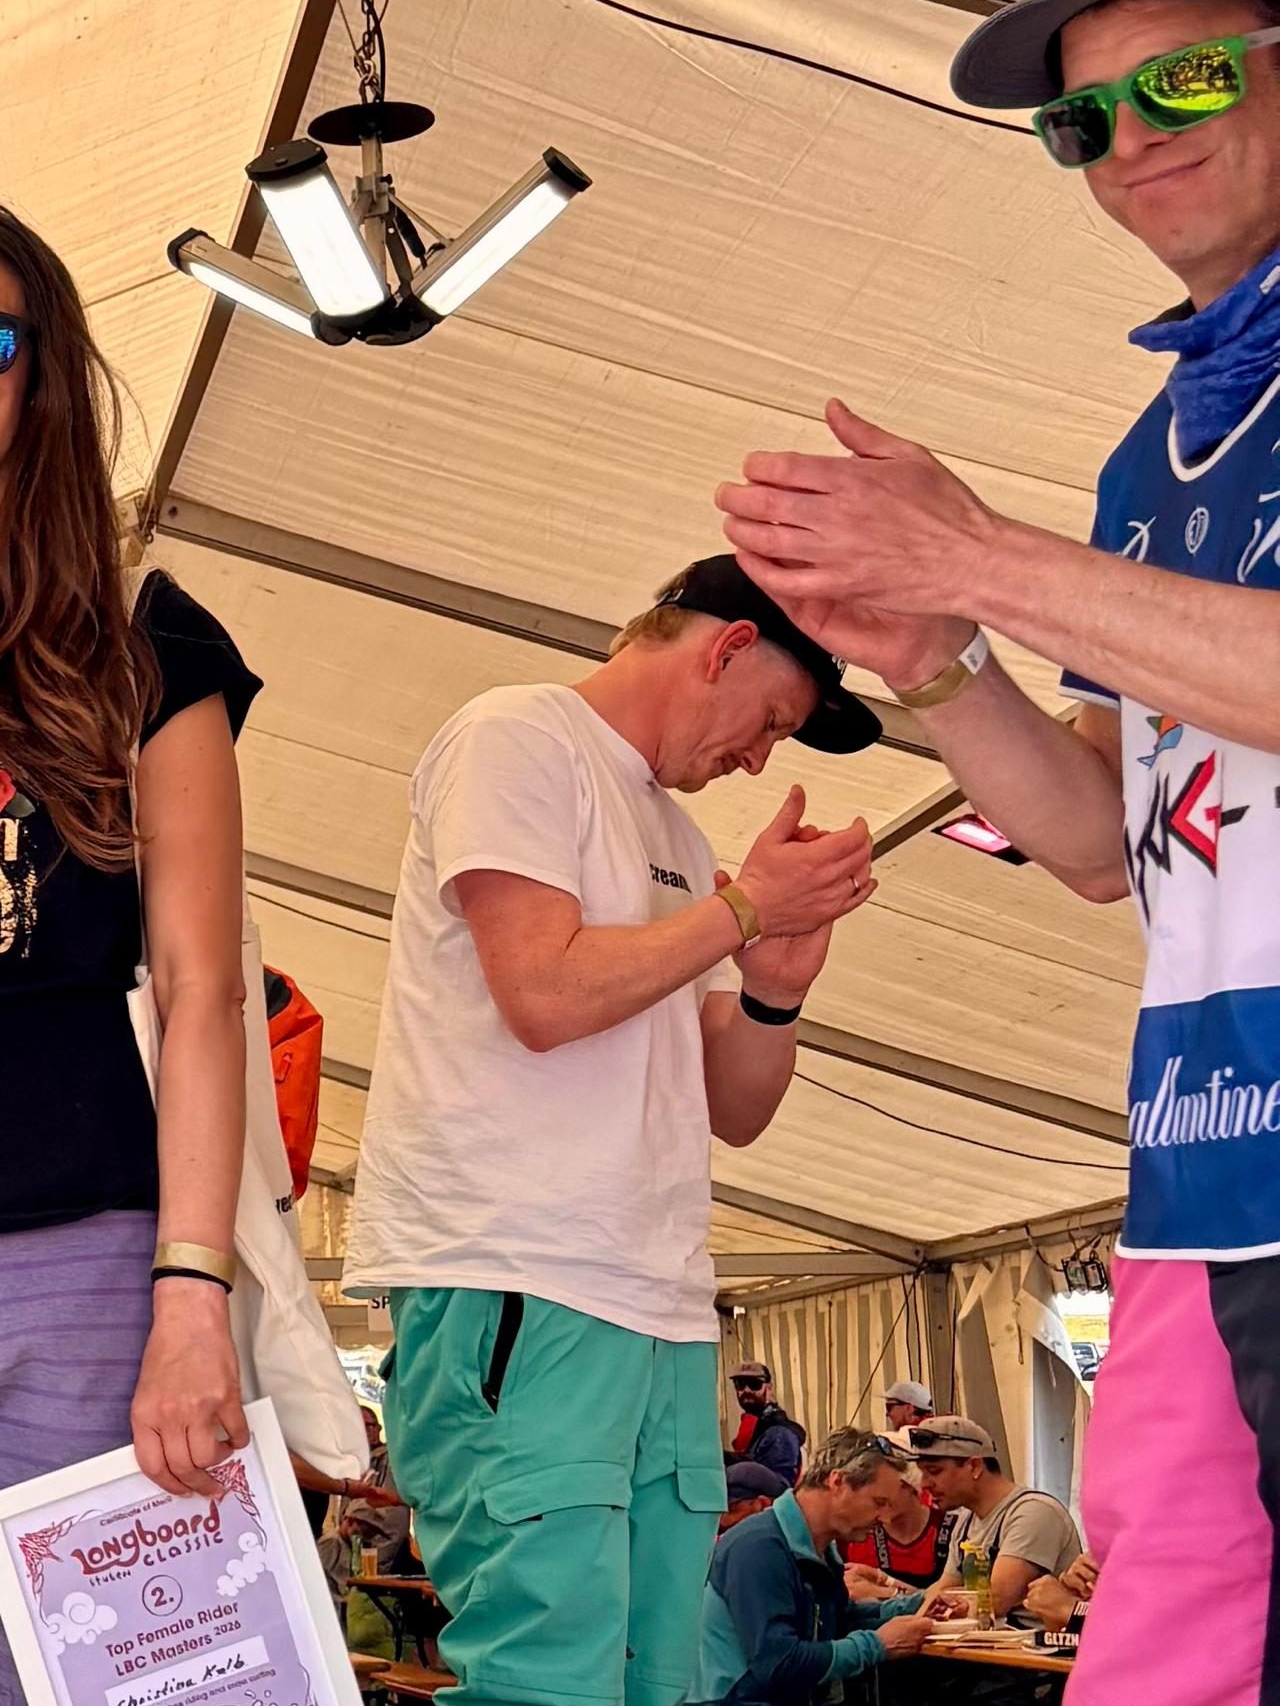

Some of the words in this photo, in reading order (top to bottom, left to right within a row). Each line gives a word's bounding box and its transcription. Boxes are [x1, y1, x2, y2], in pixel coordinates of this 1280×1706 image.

[150, 1586, 175, 1608] 2.
[105, 1640, 135, 1659] Top
[136, 1617, 195, 1646] Female
[197, 1602, 239, 1625] Rider
[114, 1655, 148, 1677] LBC
[150, 1633, 213, 1665] Masters
